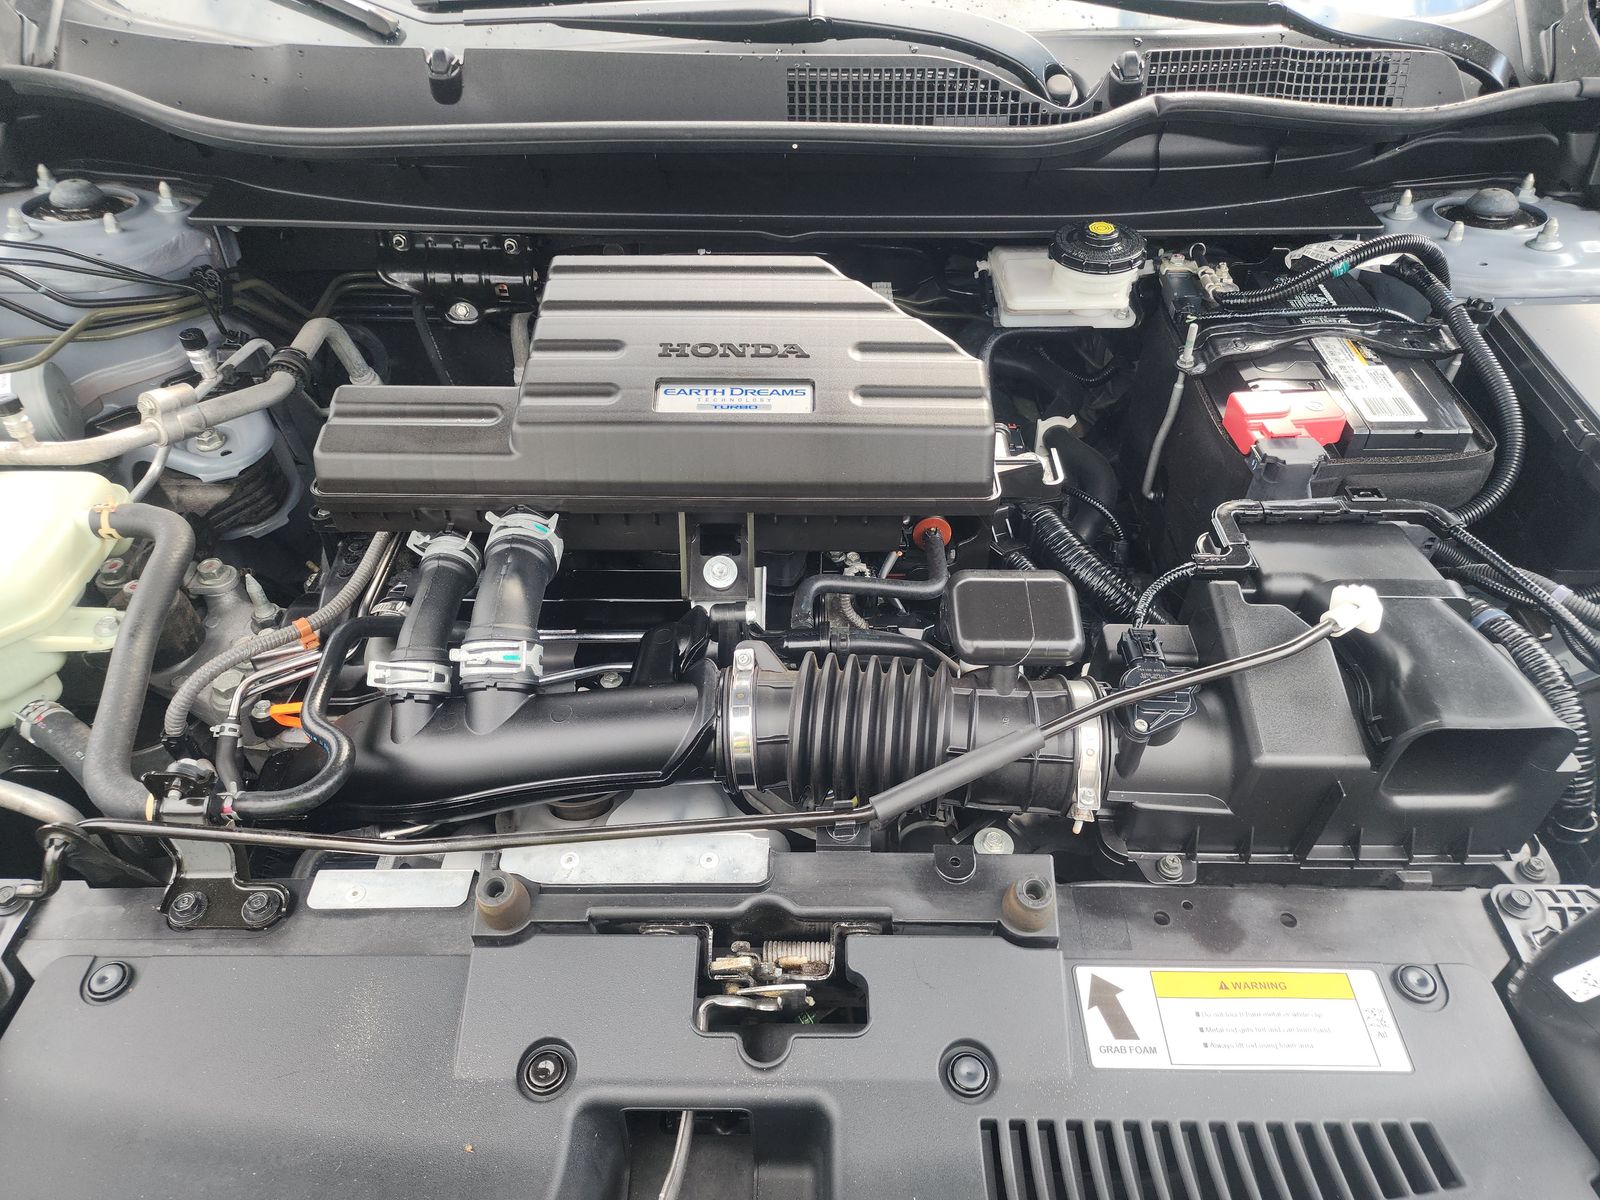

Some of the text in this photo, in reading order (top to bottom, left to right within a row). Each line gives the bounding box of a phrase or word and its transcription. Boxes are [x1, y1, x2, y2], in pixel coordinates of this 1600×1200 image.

[658, 342, 811, 358] HONDA
[663, 388, 726, 396] EARTH
[1231, 981, 1288, 991] WARNING
[1099, 1045, 1158, 1055] GRAB FOAM
